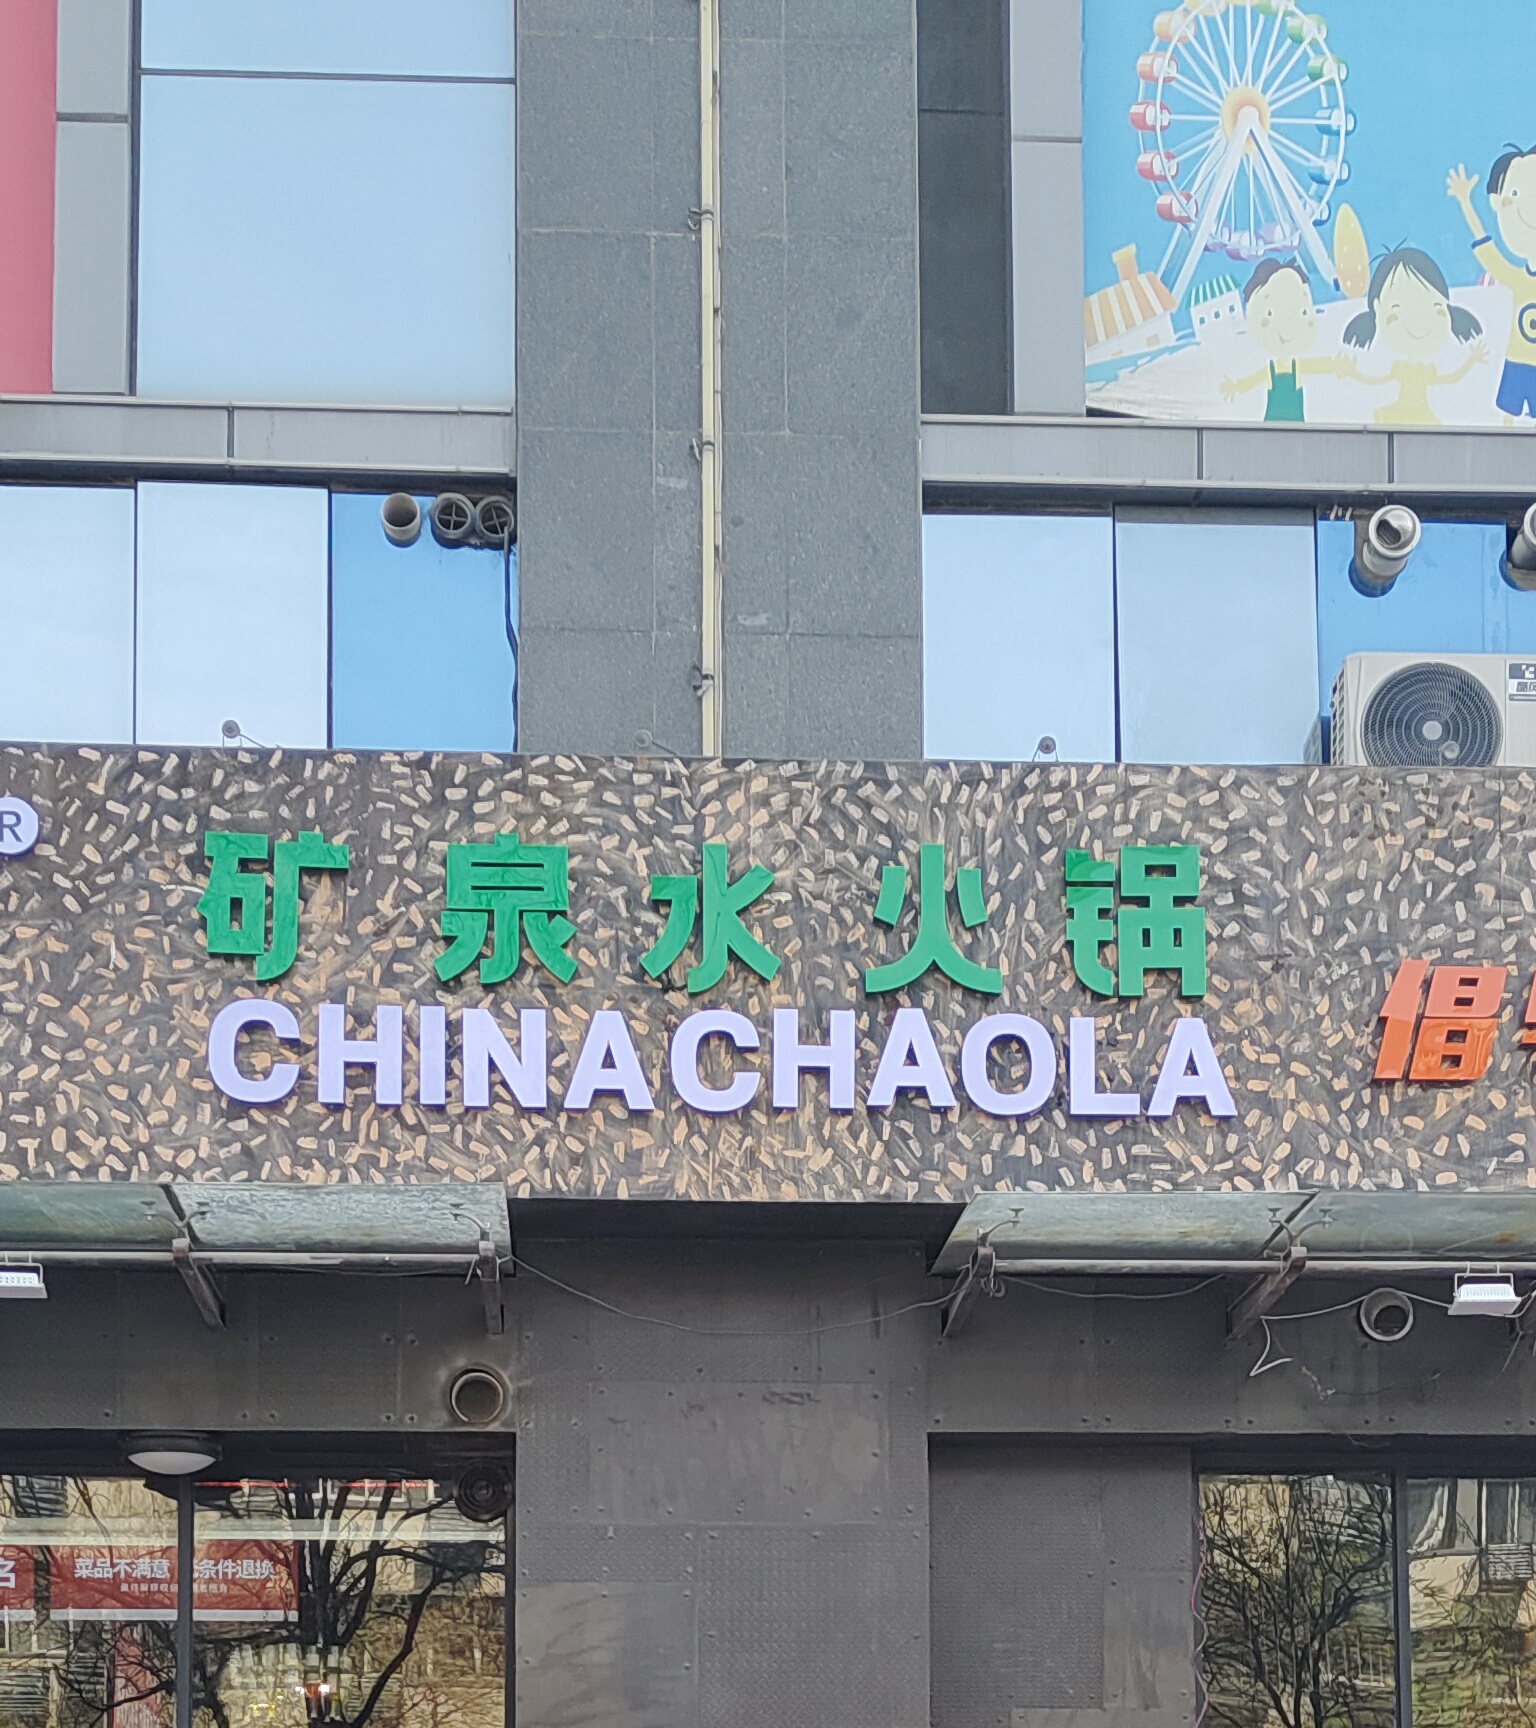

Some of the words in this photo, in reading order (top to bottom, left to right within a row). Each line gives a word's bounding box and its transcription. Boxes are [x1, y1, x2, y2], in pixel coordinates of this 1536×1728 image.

[197, 831, 1208, 998] 矿泉水火锅
[206, 1000, 1237, 1118] CHINACHAOLA
[74, 1558, 170, 1579] 菜品不满意
[192, 1559, 276, 1580] 条件退换
